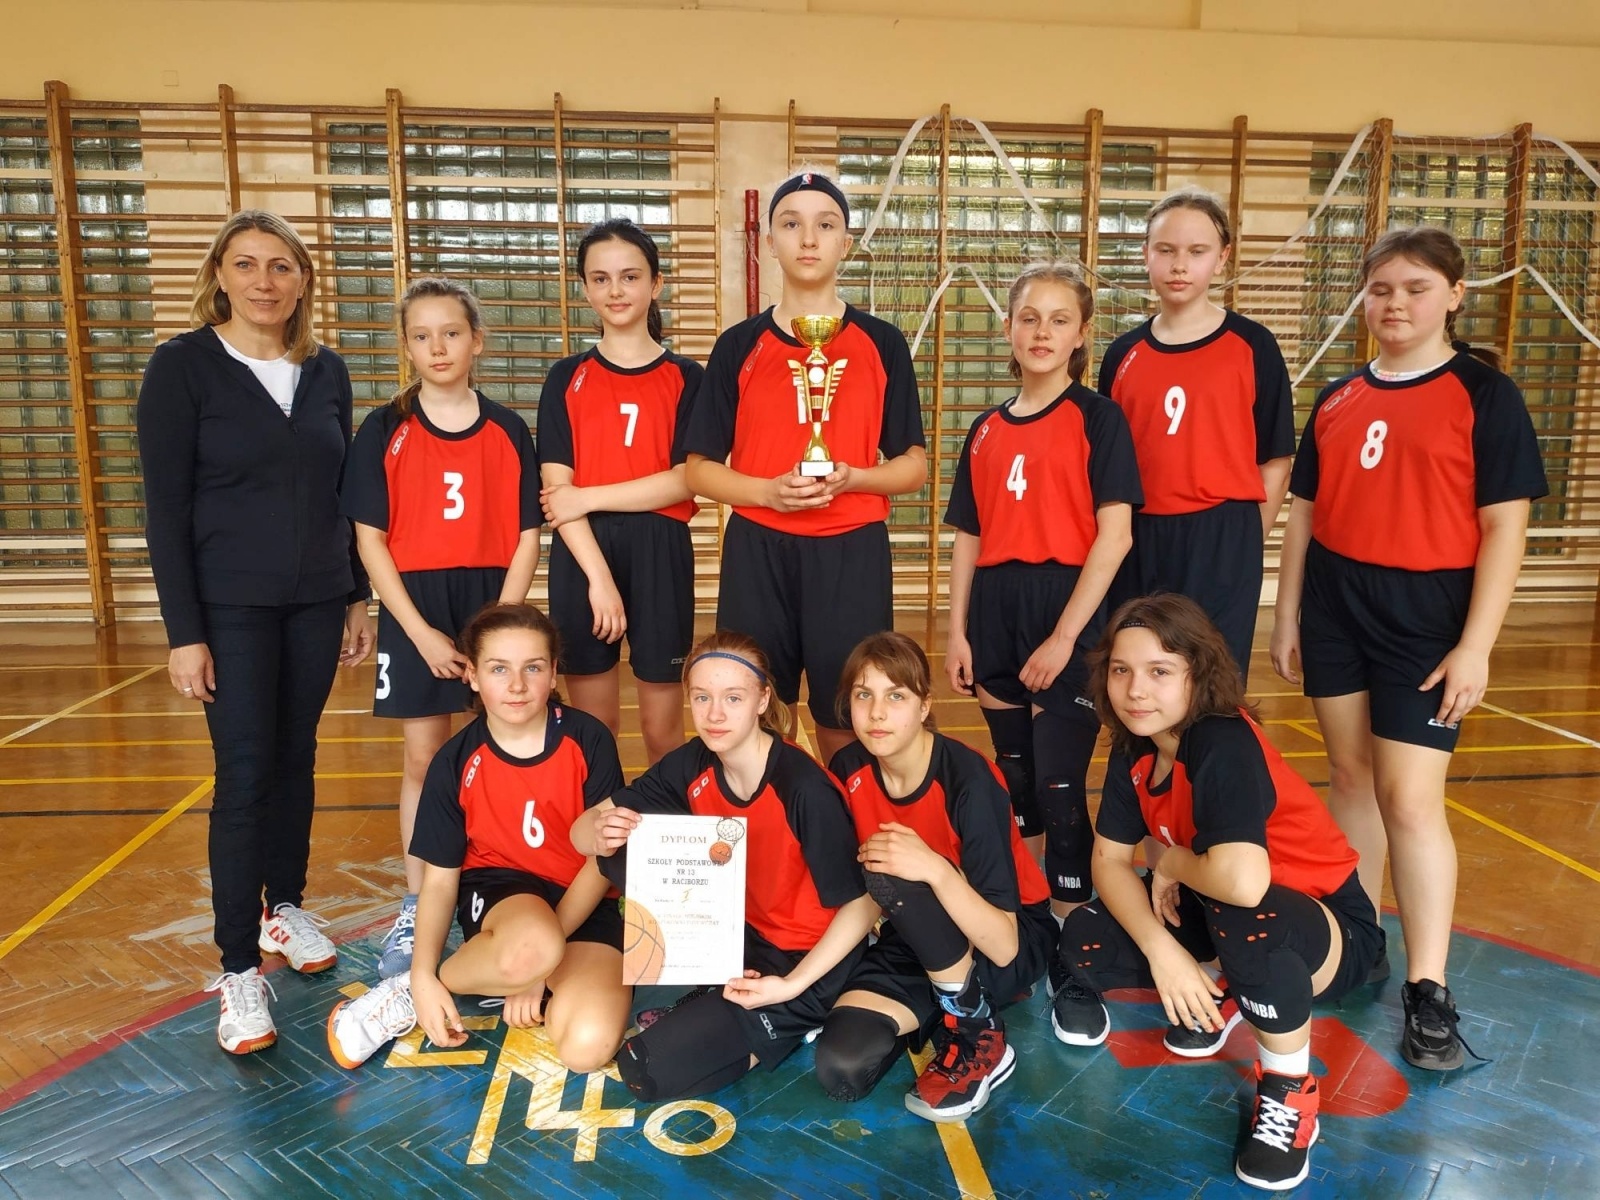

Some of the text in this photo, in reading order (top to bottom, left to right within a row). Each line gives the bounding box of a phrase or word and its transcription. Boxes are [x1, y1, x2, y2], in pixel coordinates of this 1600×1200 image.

[619, 403, 639, 448] 7
[1164, 385, 1187, 436] 9
[1360, 420, 1388, 470] 8
[443, 472, 465, 520] 3
[1006, 454, 1028, 501] 4
[375, 652, 391, 700] 3
[1074, 696, 1097, 710] COL
[522, 800, 545, 848] 6
[661, 835, 707, 844] DYPLOM
[1014, 815, 1026, 827] BA
[676, 868, 686, 876] NR
[1064, 876, 1081, 889] NBA
[471, 891, 485, 923] 6
[1249, 999, 1279, 1019] NBA
